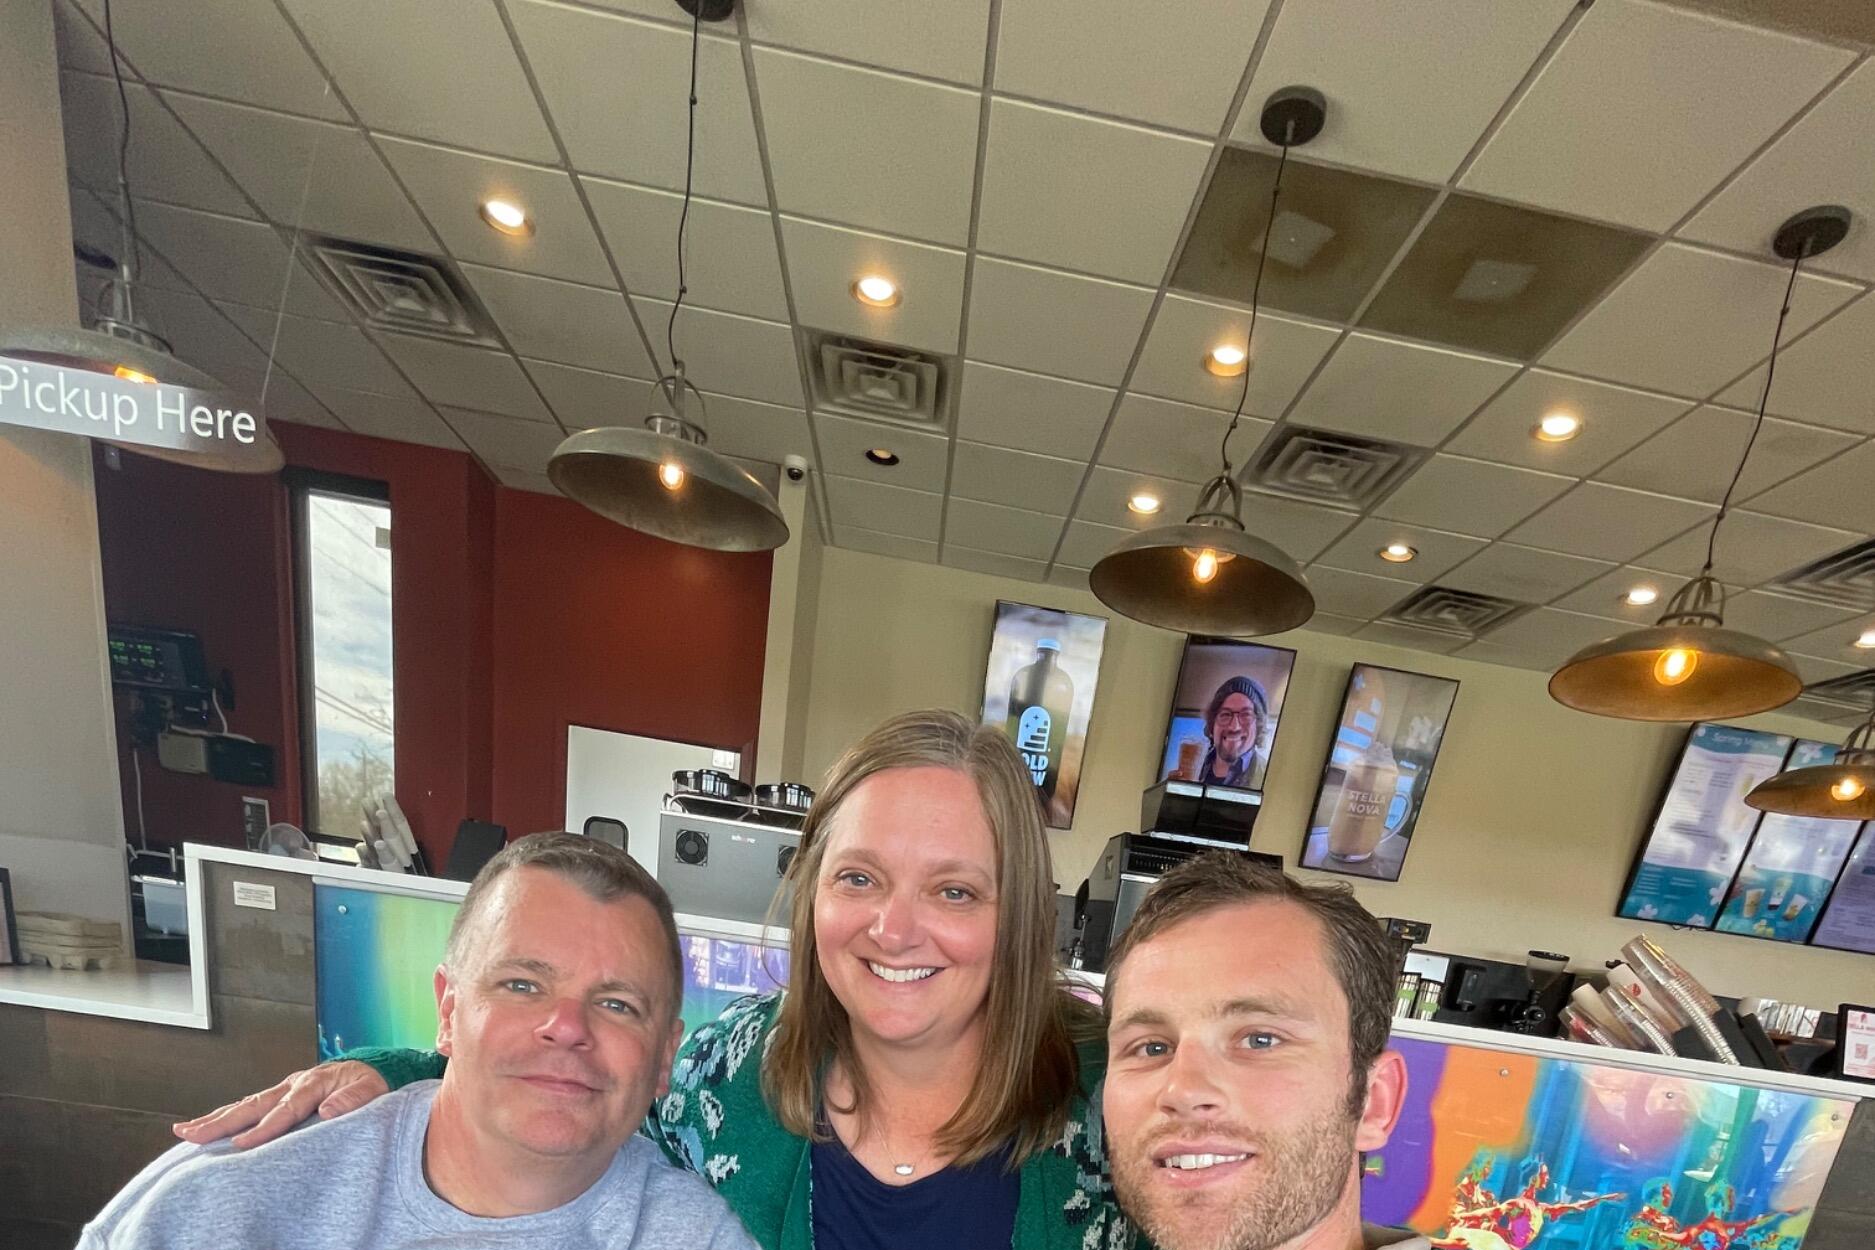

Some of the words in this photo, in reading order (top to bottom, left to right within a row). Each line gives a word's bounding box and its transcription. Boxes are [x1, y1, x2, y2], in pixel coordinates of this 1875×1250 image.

[0, 364, 138, 436] Pickup
[156, 389, 256, 444] Here
[1348, 790, 1386, 804] STELLA
[1348, 802, 1380, 816] NOVA
